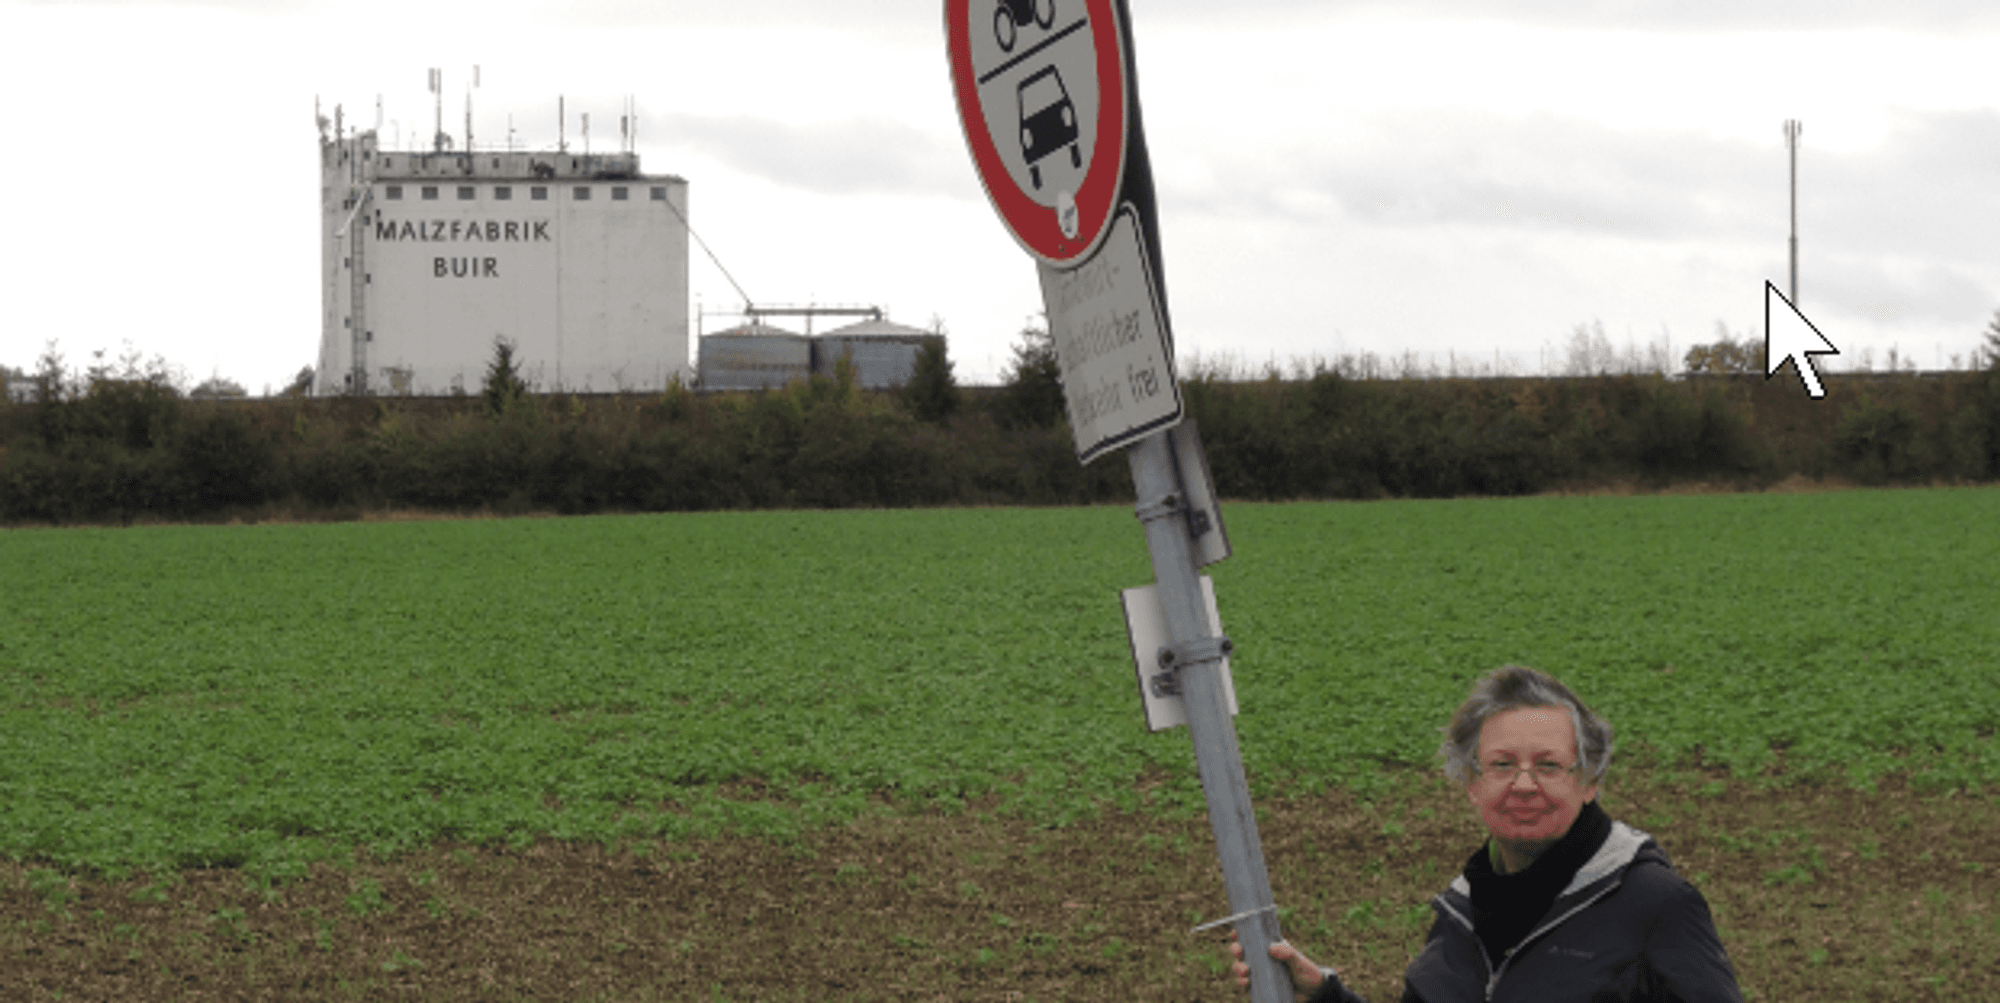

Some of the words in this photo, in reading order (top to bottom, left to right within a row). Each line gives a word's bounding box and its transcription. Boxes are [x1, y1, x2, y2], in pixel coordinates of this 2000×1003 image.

[376, 220, 552, 242] MALZFABRIK
[433, 256, 500, 278] BUIR
[1126, 354, 1161, 404] frei
